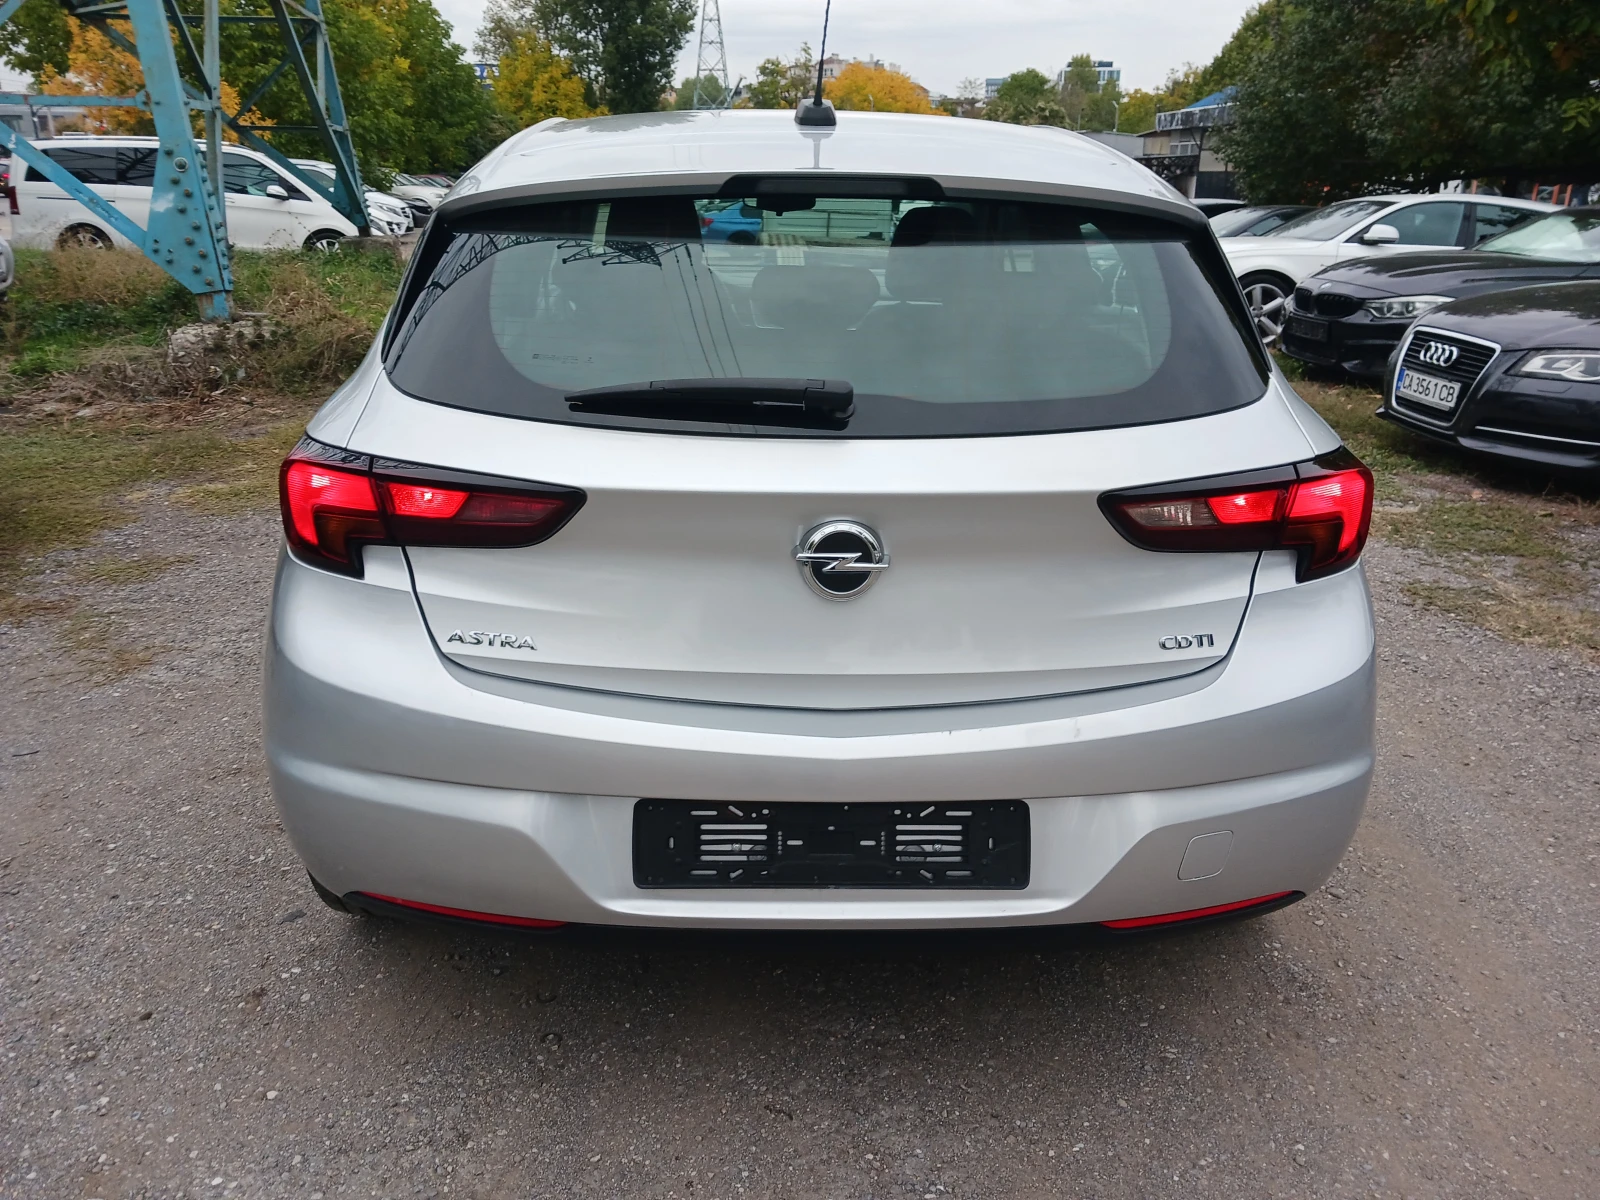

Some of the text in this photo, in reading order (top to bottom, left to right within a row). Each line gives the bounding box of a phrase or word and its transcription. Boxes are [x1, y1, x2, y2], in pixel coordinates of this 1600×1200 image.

[1413, 377, 1439, 399] 3561
[1439, 384, 1455, 403] CB
[447, 629, 537, 651] ASTRA
[1159, 633, 1214, 650] CDTI
